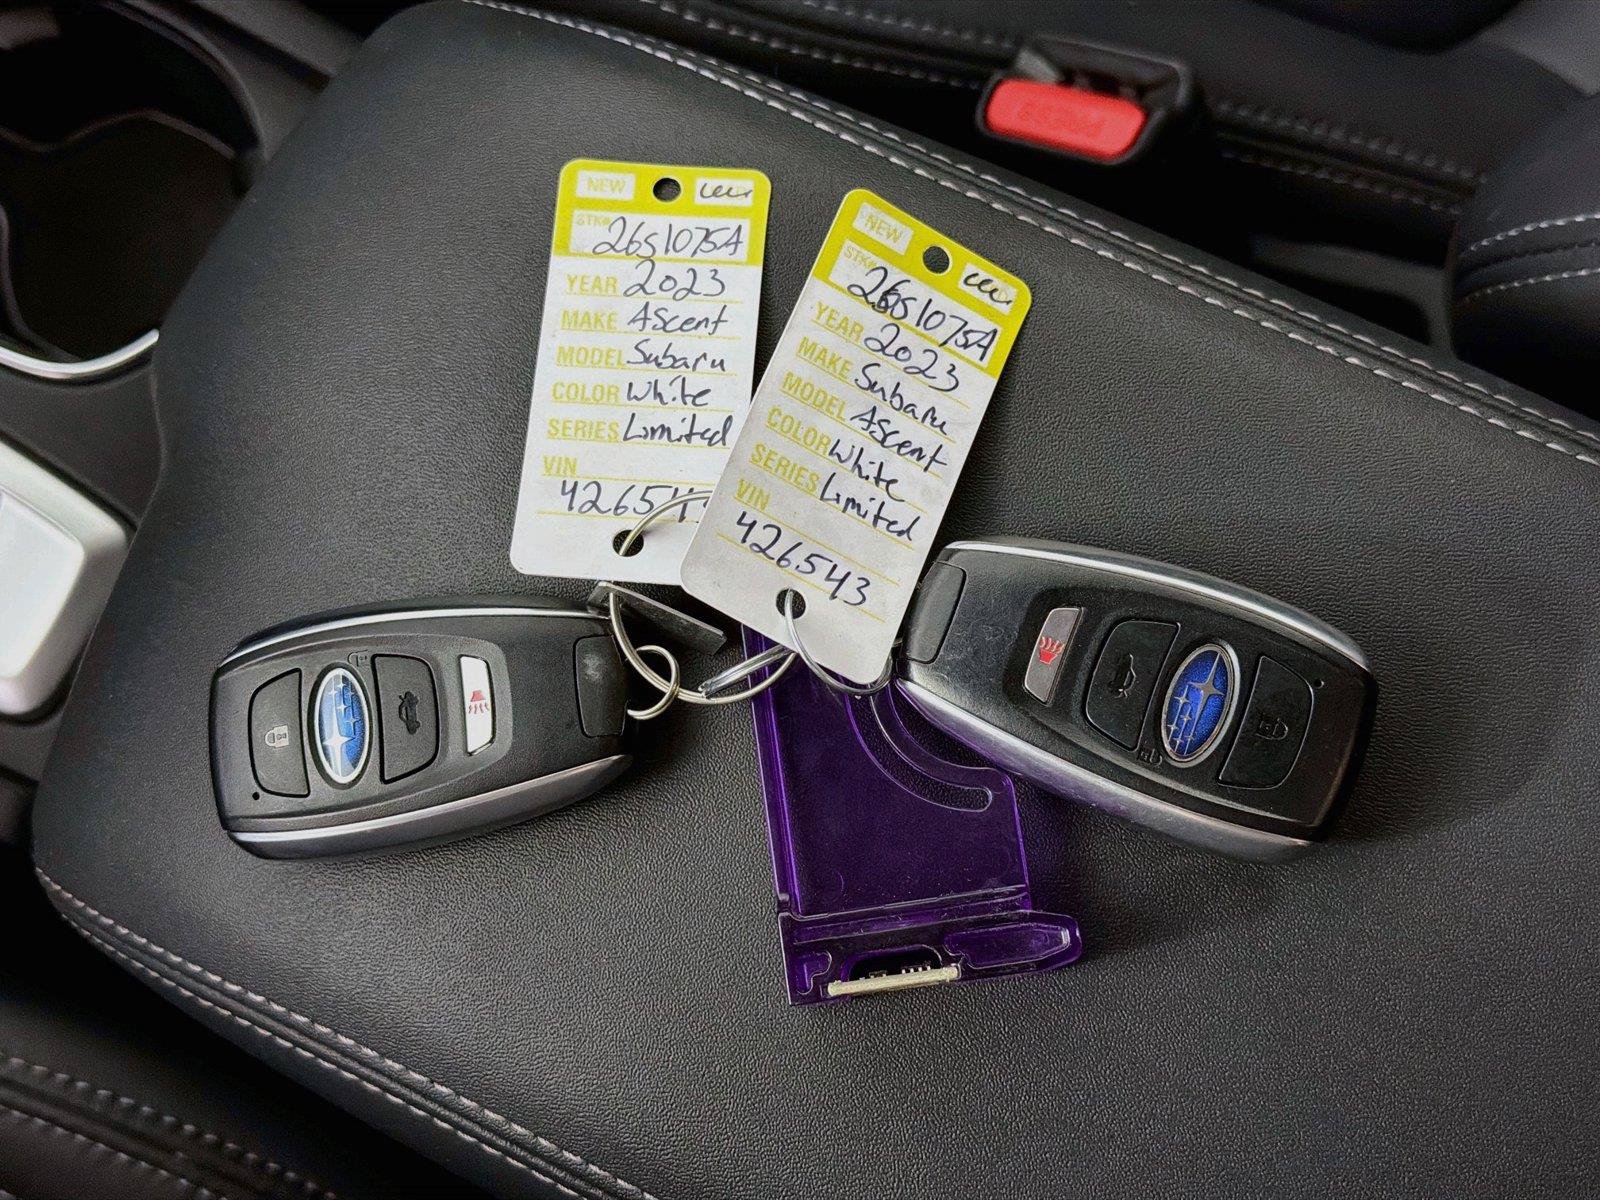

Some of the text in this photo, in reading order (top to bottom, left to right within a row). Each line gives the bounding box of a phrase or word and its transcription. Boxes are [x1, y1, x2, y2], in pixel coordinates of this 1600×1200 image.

[586, 177, 626, 194] NEW
[864, 213, 904, 244] NEW
[566, 274, 618, 295] YEAR
[623, 258, 726, 301] 2023
[561, 309, 617, 331] MAKE
[814, 301, 864, 345] YEAR
[556, 345, 626, 368] MODEL
[626, 338, 726, 372] Subaru
[797, 336, 851, 378] MAKE
[864, 322, 960, 393] 2023
[552, 381, 620, 401] COLOR
[781, 371, 847, 423] MODEL
[854, 362, 949, 436] Subaru
[547, 418, 620, 442] SERIES
[622, 412, 733, 447] Limited
[767, 405, 831, 457] COLOR
[542, 455, 577, 476] VIN
[751, 442, 821, 494] SERIES
[560, 479, 711, 523] 42654
[736, 477, 772, 513] VIN
[819, 472, 921, 541] Limited
[736, 510, 871, 607] 426543
